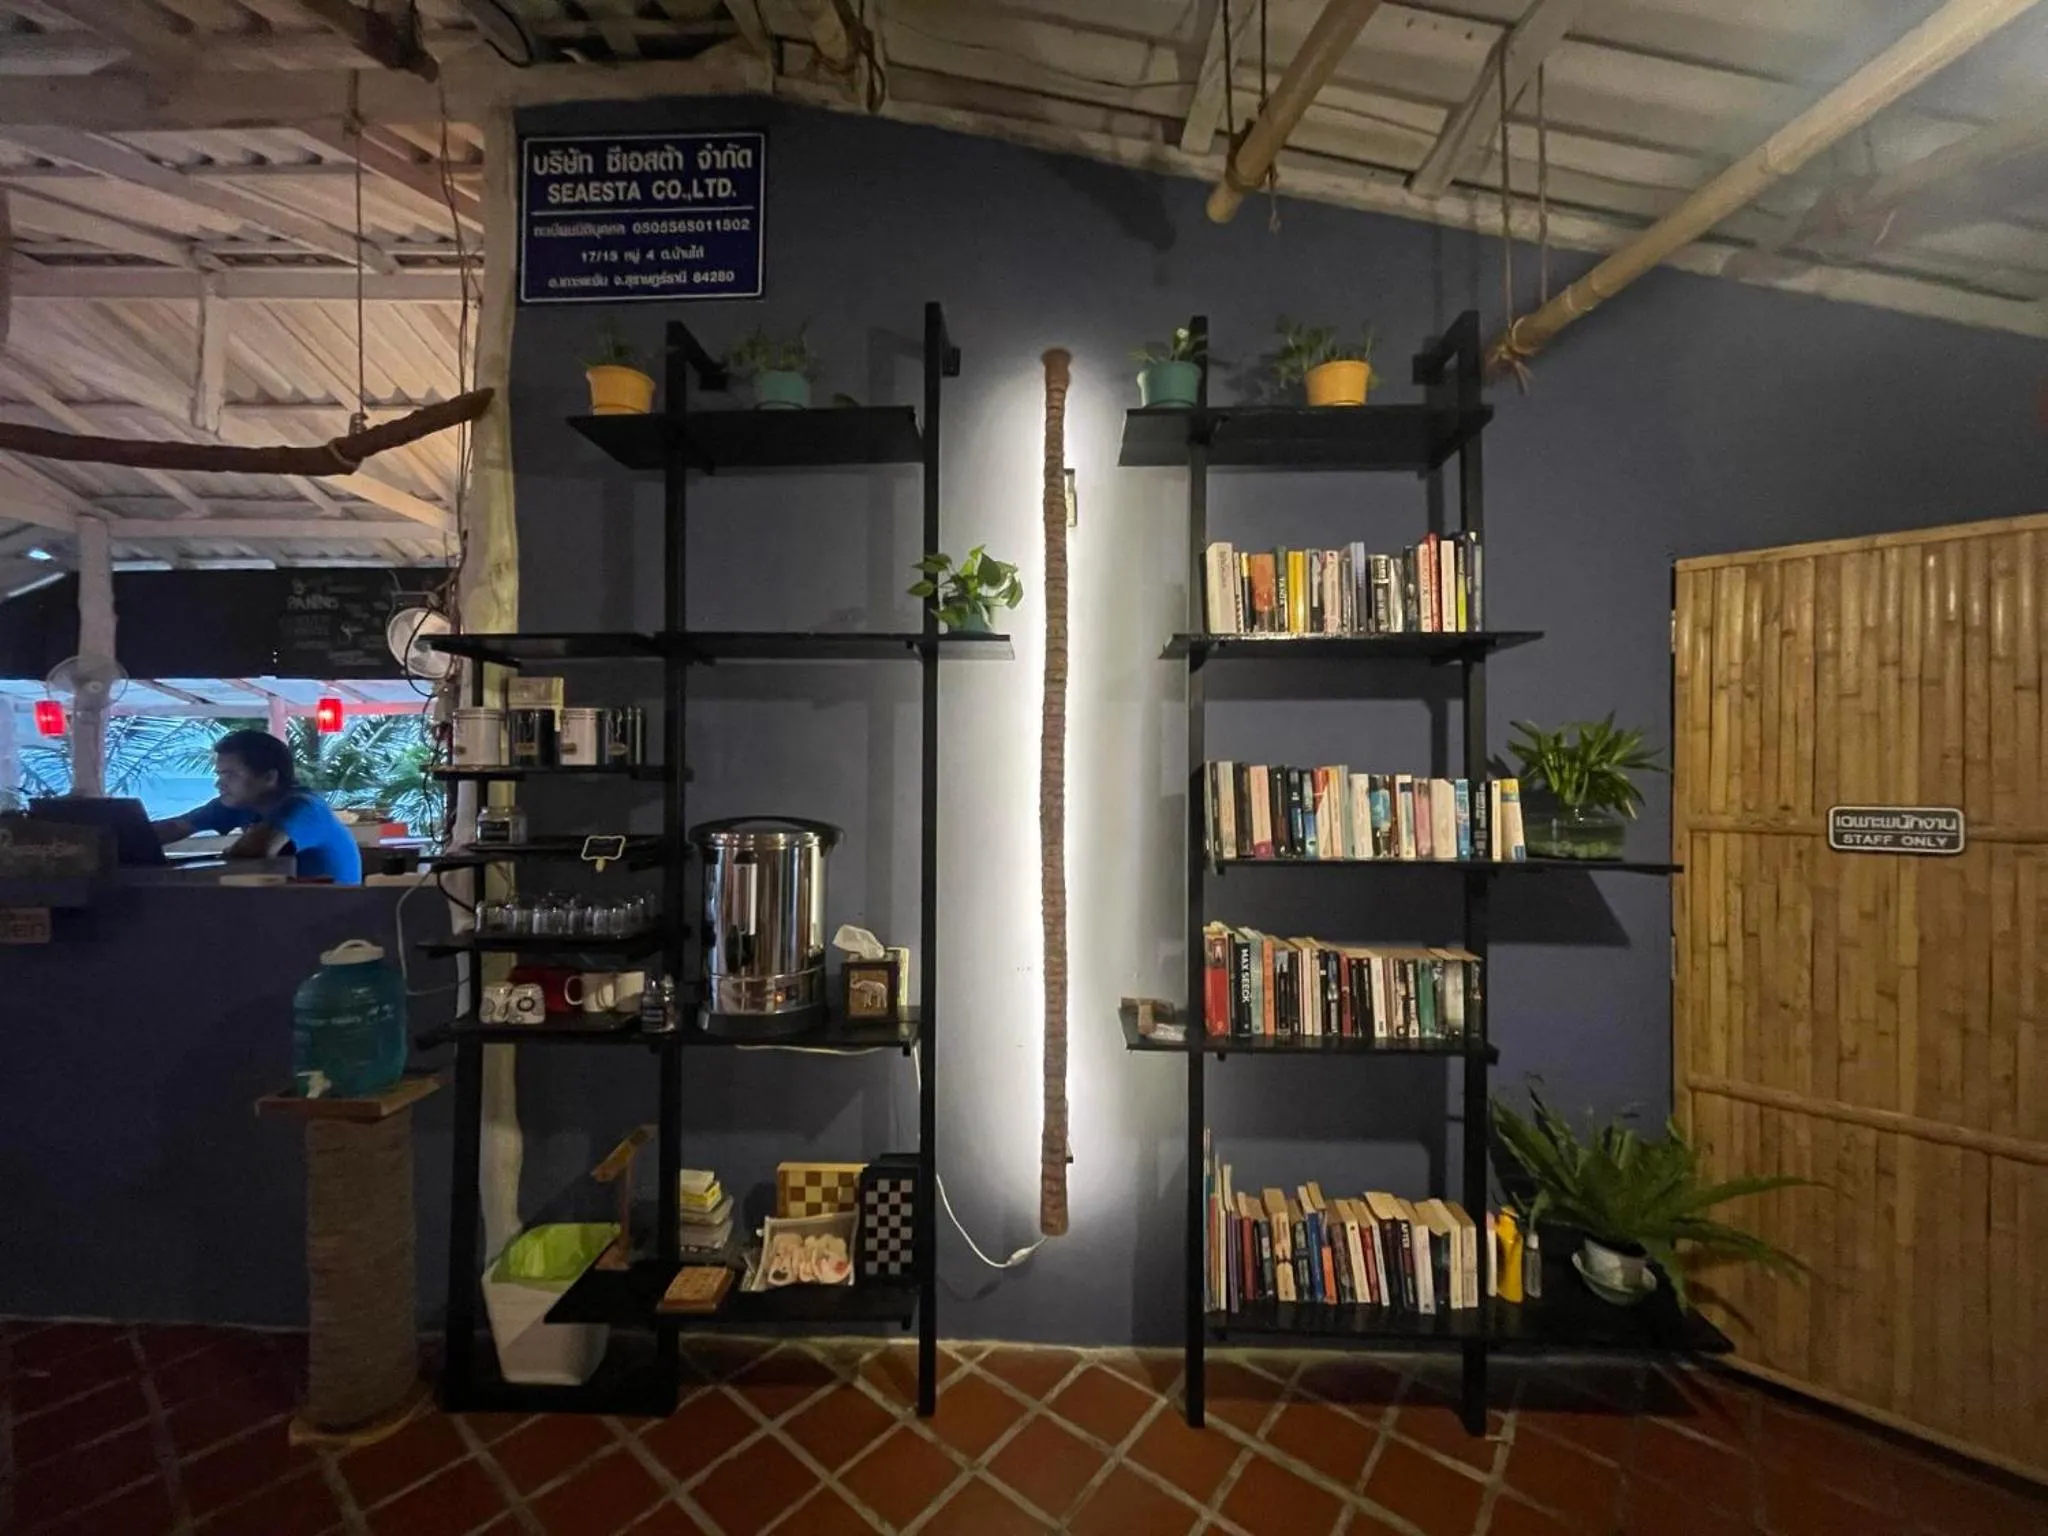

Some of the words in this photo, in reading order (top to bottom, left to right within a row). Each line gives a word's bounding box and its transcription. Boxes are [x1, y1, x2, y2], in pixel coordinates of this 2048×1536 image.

[533, 147, 594, 176] บริษัท
[697, 143, 752, 170] จำกัด
[547, 180, 642, 203] SEAESTA
[652, 178, 737, 201] CO.,LTD.
[645, 249, 655, 261] 4
[1843, 834, 1893, 845] STAFF
[1900, 836, 1949, 847] ONLY
